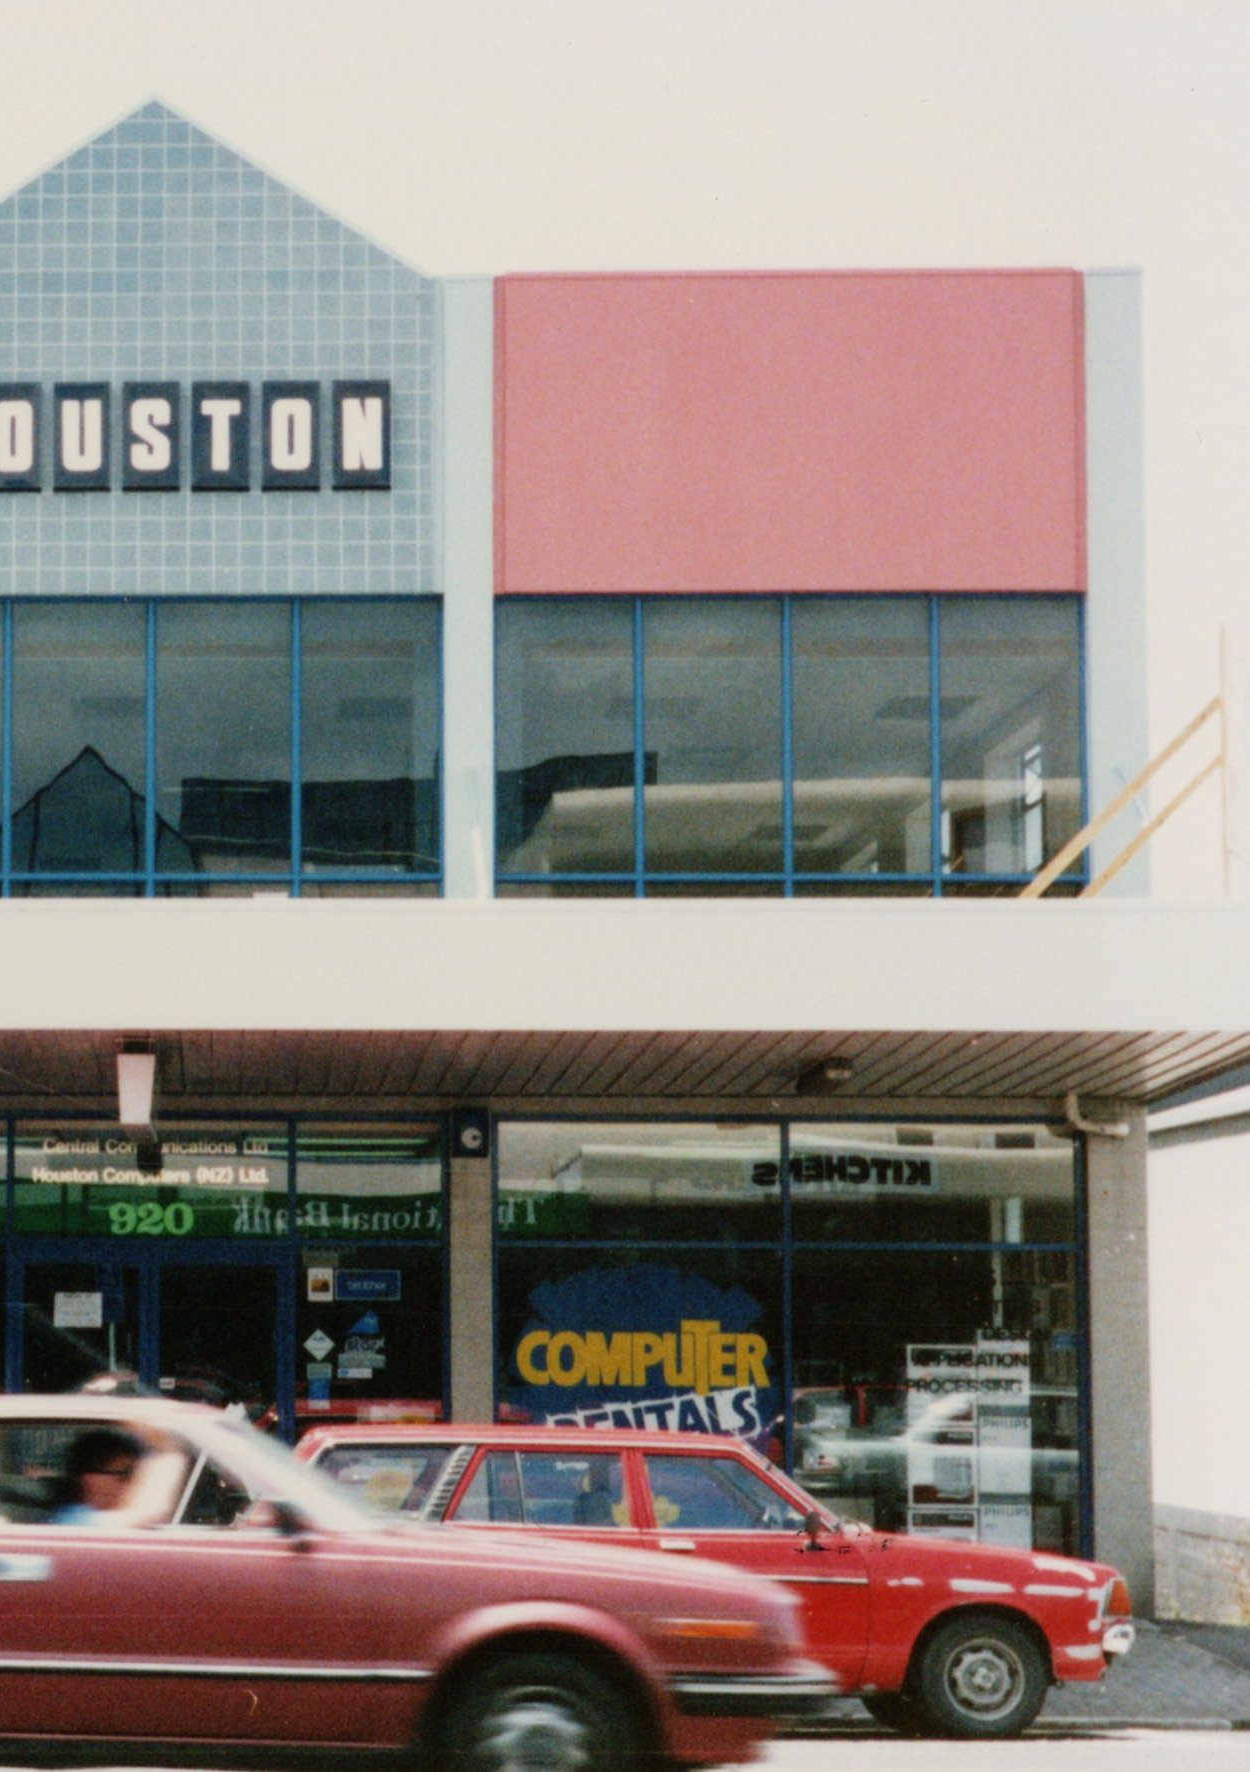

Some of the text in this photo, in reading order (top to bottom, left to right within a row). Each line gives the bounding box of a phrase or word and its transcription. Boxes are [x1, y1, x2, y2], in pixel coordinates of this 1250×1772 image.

[42, 1136, 100, 1154] Central
[105, 1137, 238, 1155] Comnications
[32, 1167, 99, 1184] Houston
[102, 1167, 191, 1187] Computers
[196, 1165, 234, 1185] (NZ)
[108, 1202, 195, 1236] 920
[516, 1320, 770, 1396] COMPUTER
[907, 1378, 1024, 1393] PROCESSING
[550, 1388, 760, 1436] TALS
[982, 1419, 1029, 1429] PHILIPS
[983, 1507, 1031, 1518] PHILIPS
